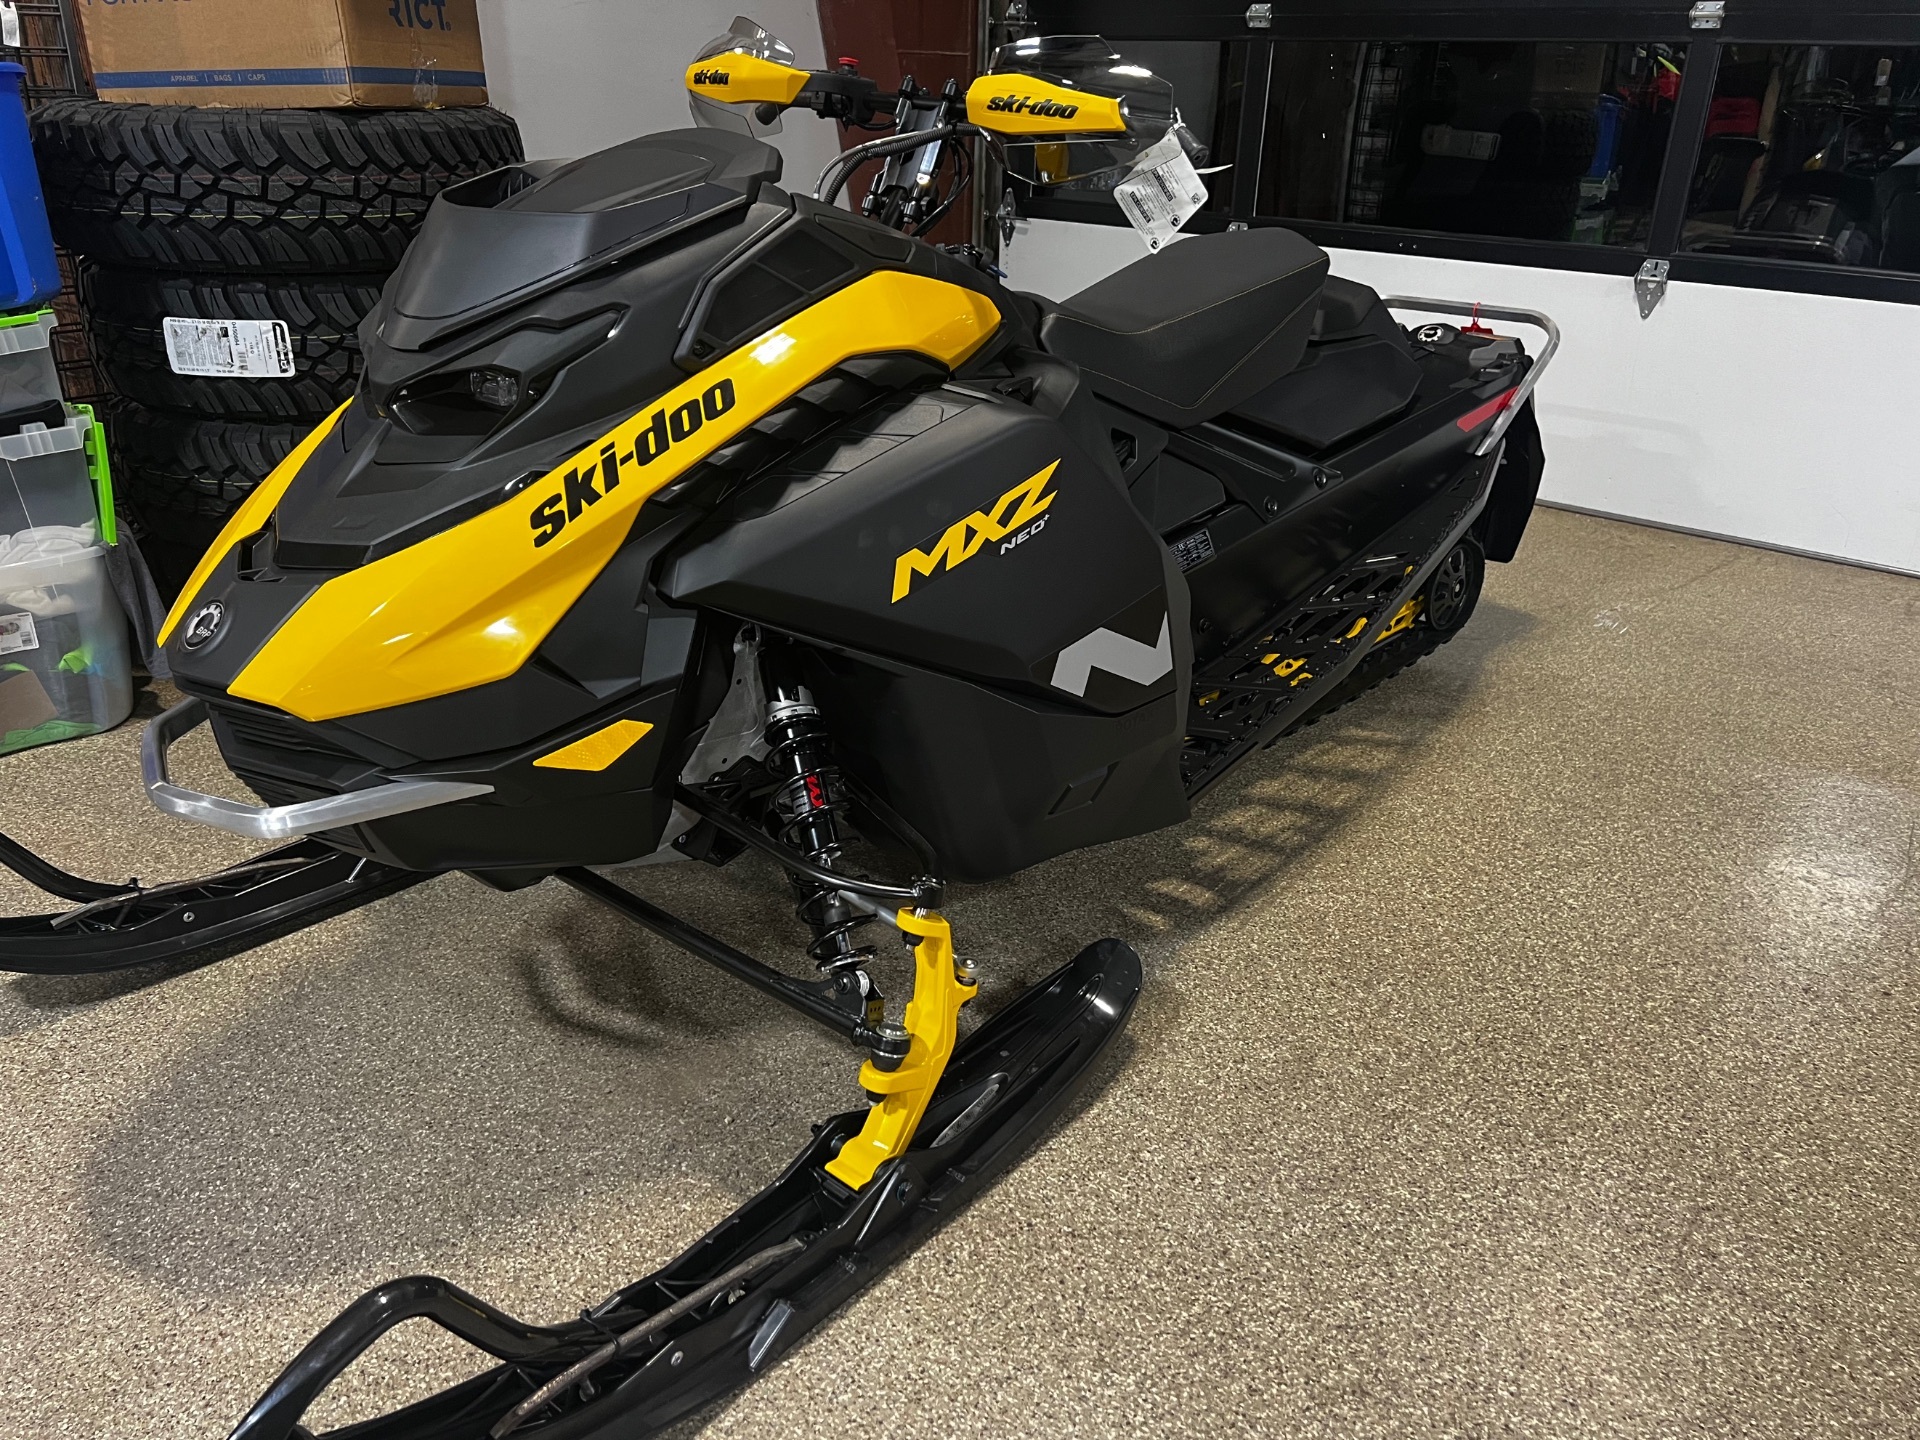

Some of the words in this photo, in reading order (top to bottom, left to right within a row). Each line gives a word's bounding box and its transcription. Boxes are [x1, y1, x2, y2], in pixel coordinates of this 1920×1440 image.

[694, 69, 729, 85] ski-doo
[987, 94, 1079, 119] ski-doo
[530, 378, 736, 548] ski-doo
[891, 458, 1061, 604] MXZ
[195, 626, 212, 638] BRP
